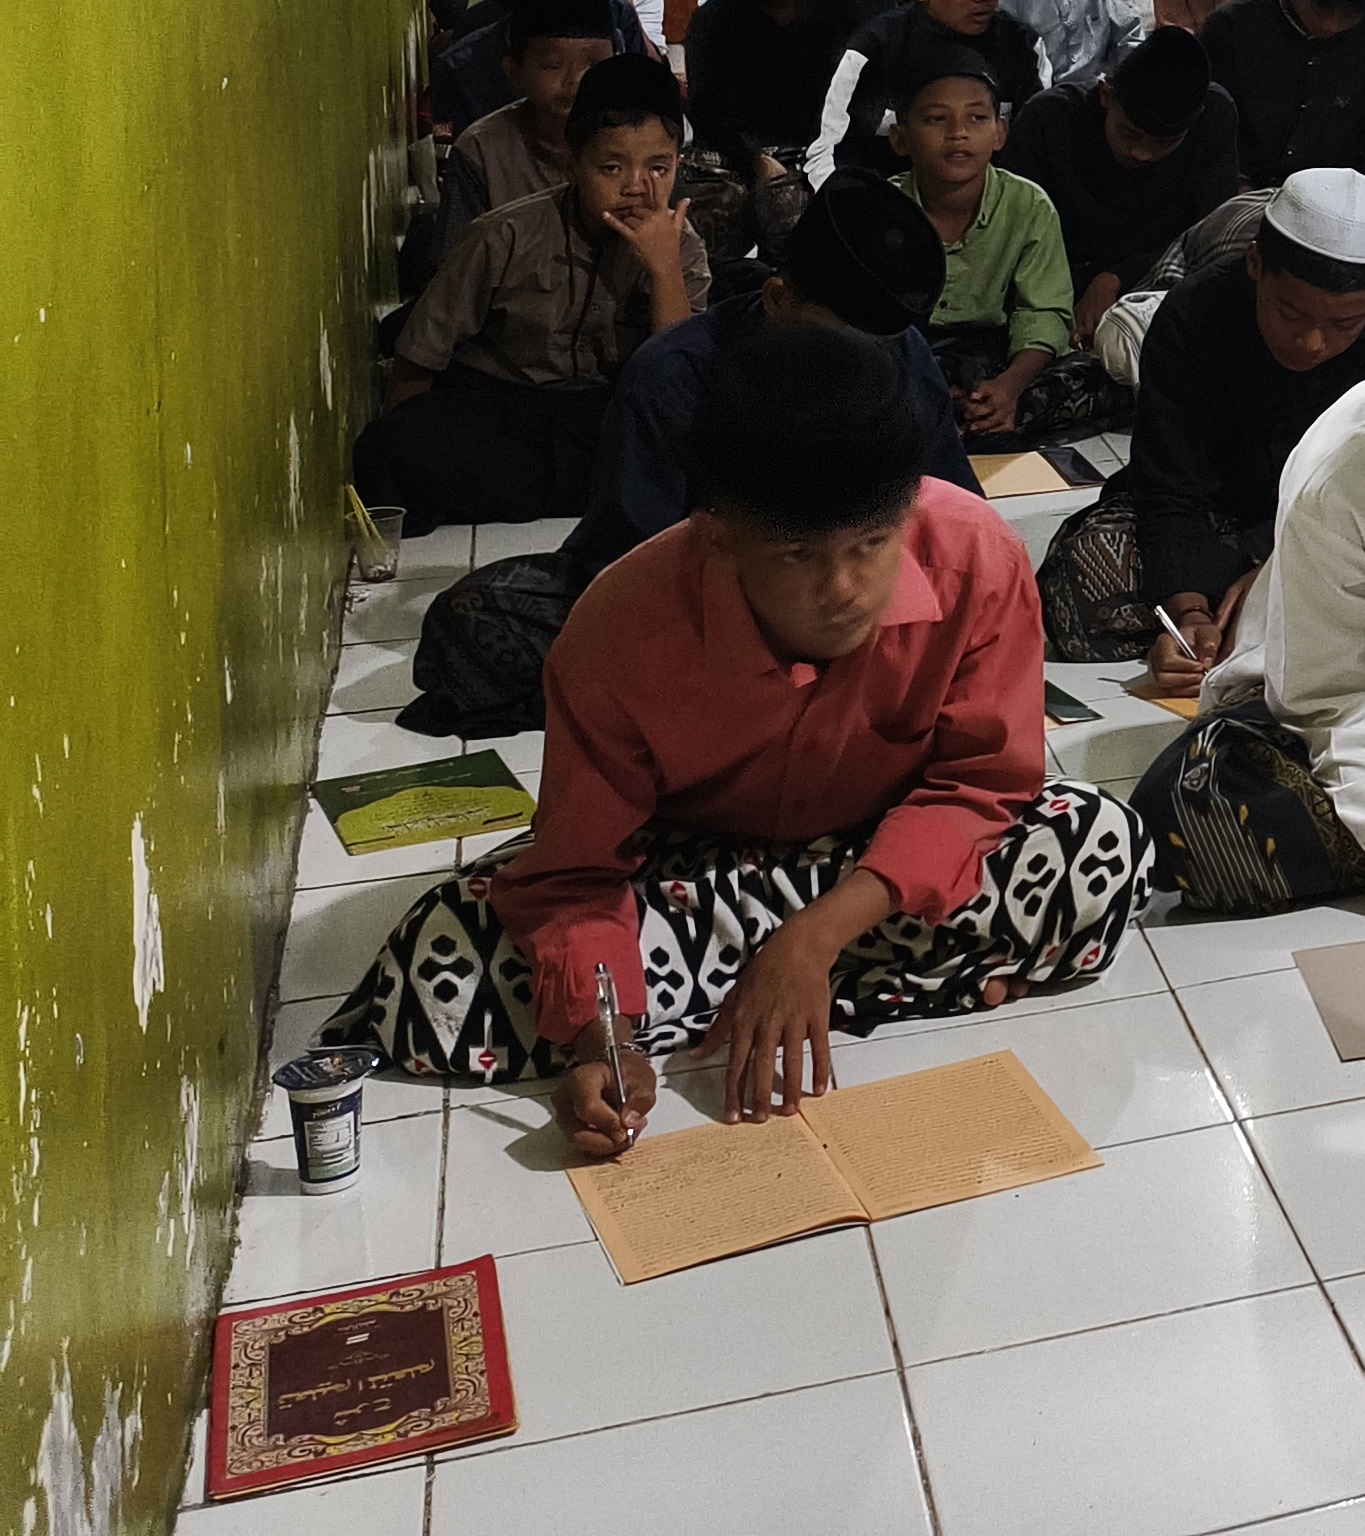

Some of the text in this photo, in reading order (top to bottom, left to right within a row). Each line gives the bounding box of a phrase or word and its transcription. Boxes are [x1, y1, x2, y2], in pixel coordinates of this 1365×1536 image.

[278, 1358, 435, 1410] تعليم المتعلم
[333, 1398, 392, 1426] شرح
